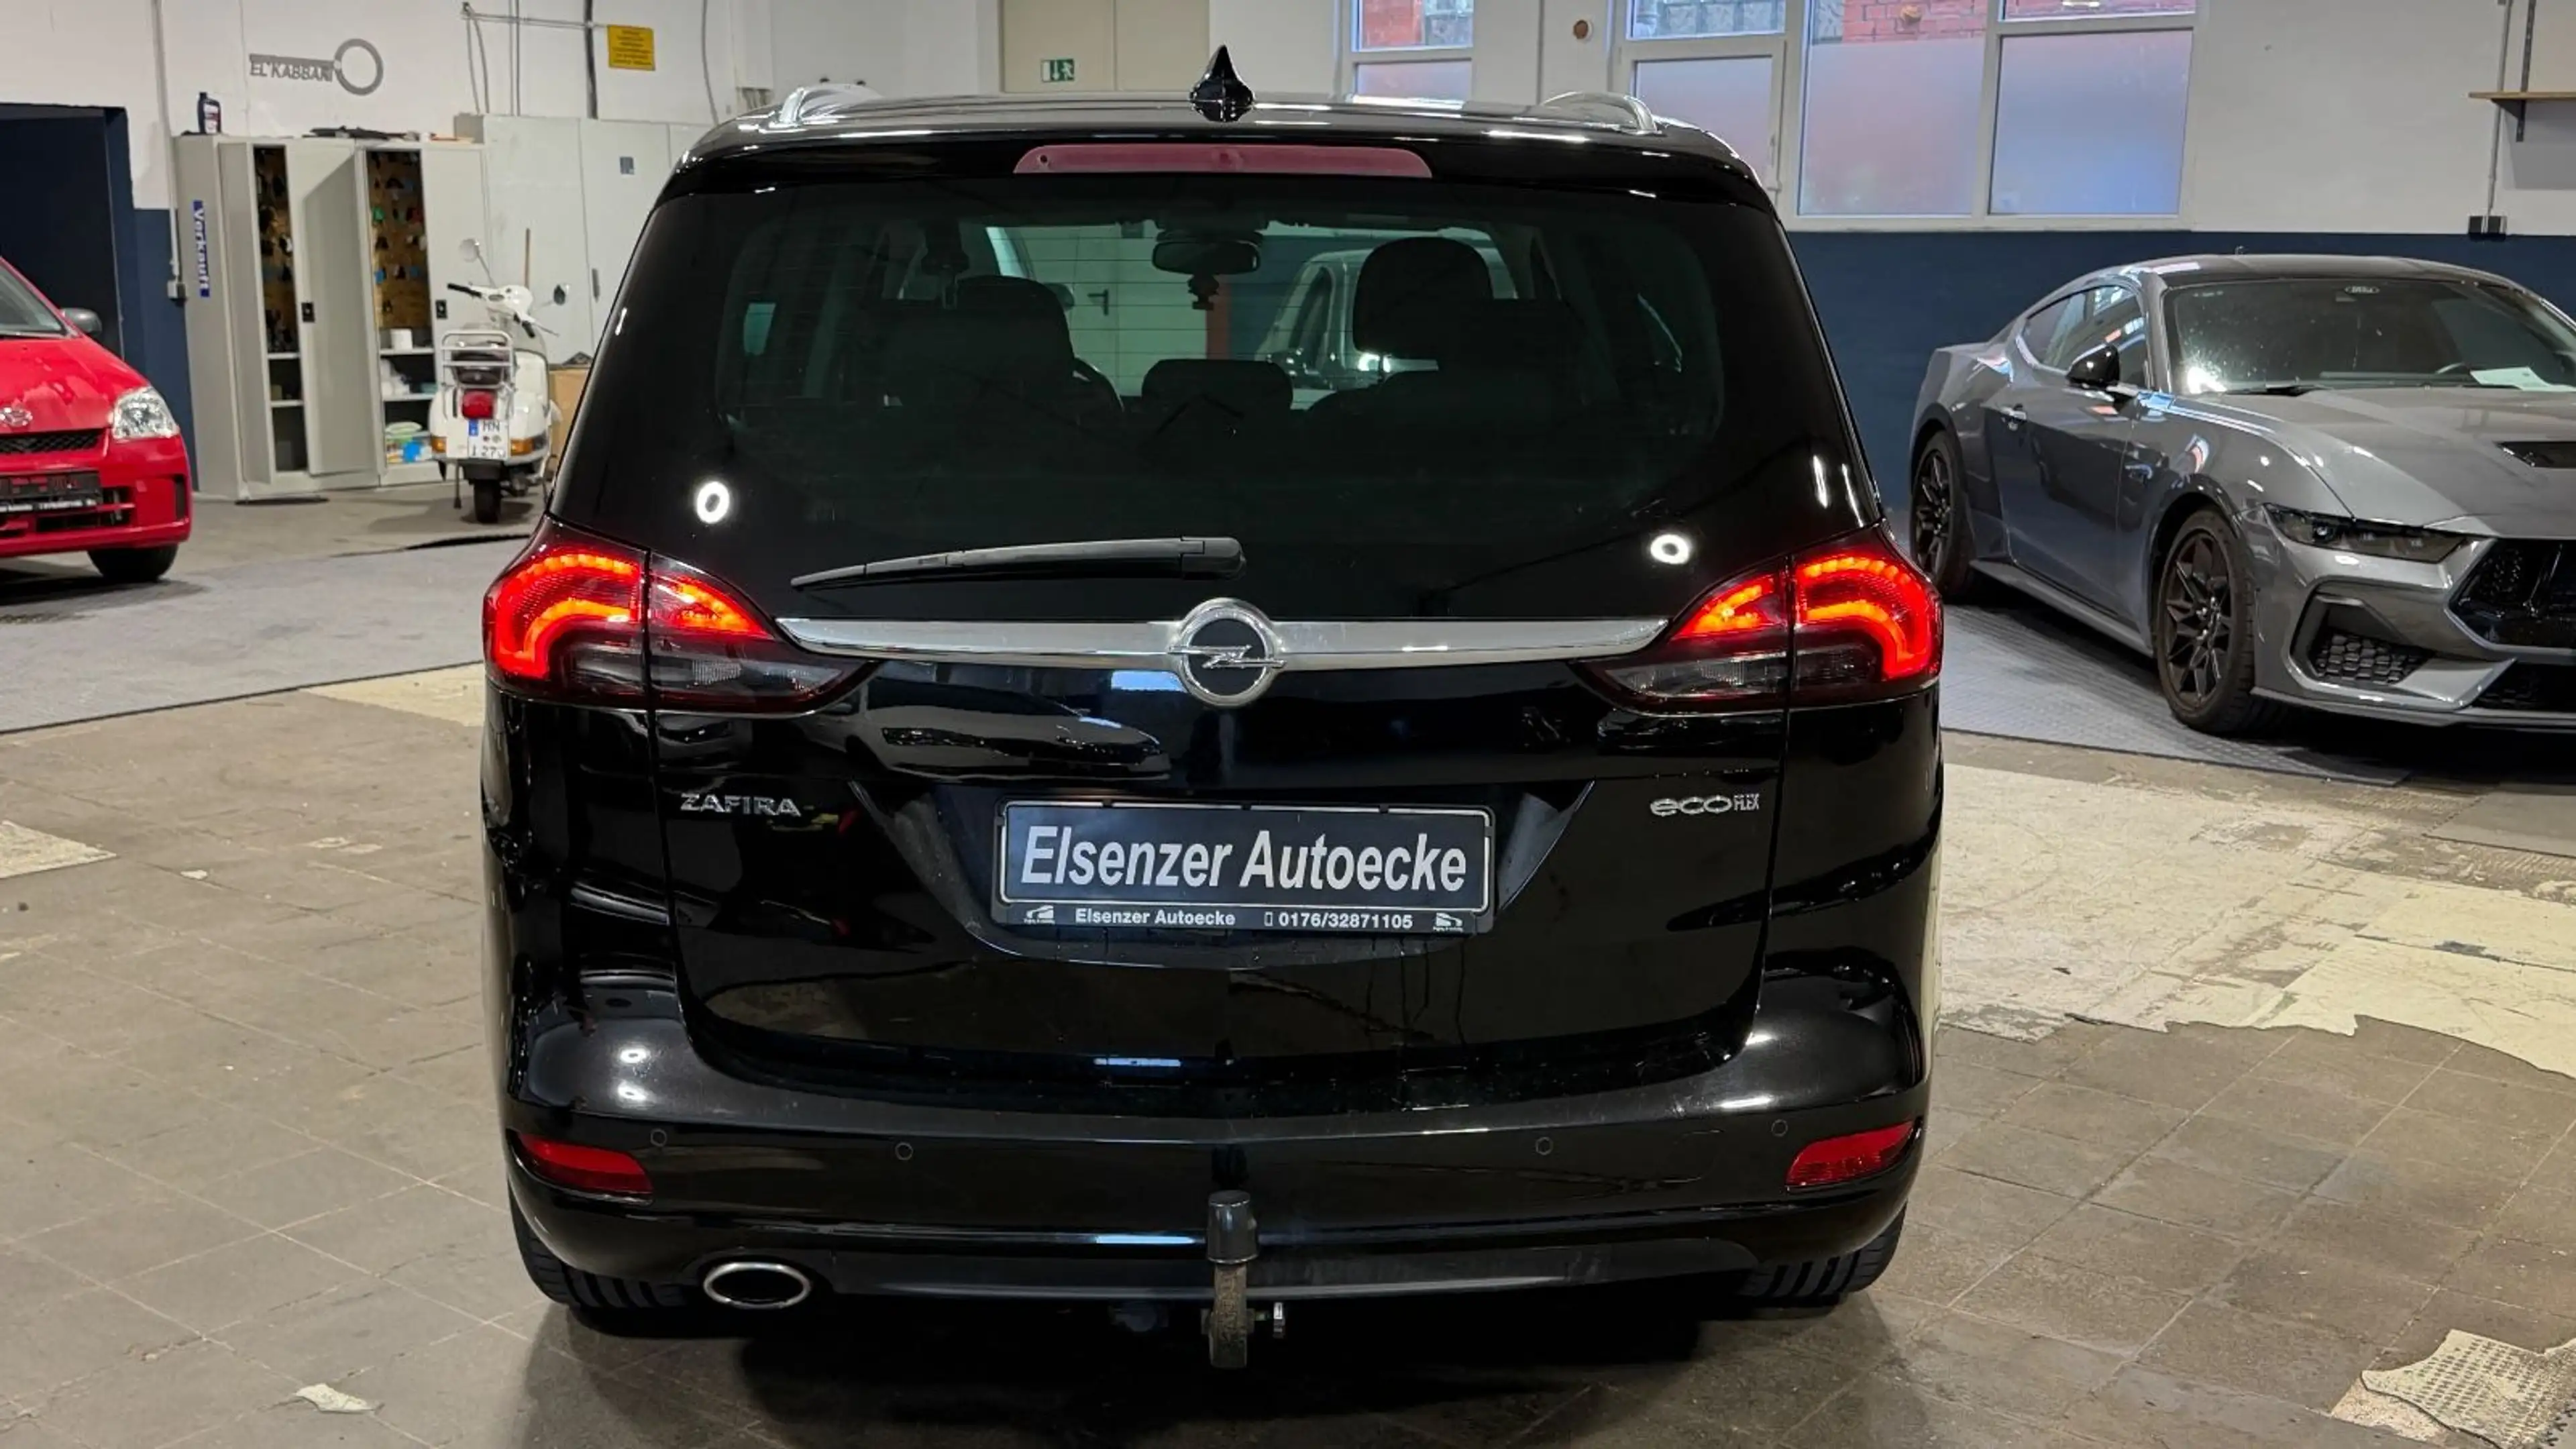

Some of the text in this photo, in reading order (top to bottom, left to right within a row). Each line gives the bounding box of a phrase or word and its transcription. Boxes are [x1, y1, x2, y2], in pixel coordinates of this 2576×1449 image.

[680, 792, 802, 817] ZAFIRA
[1020, 825, 1467, 892] Elsenzer Autoecke
[1075, 908, 1413, 929] Elsenzer Autoecke 0176/32871105
